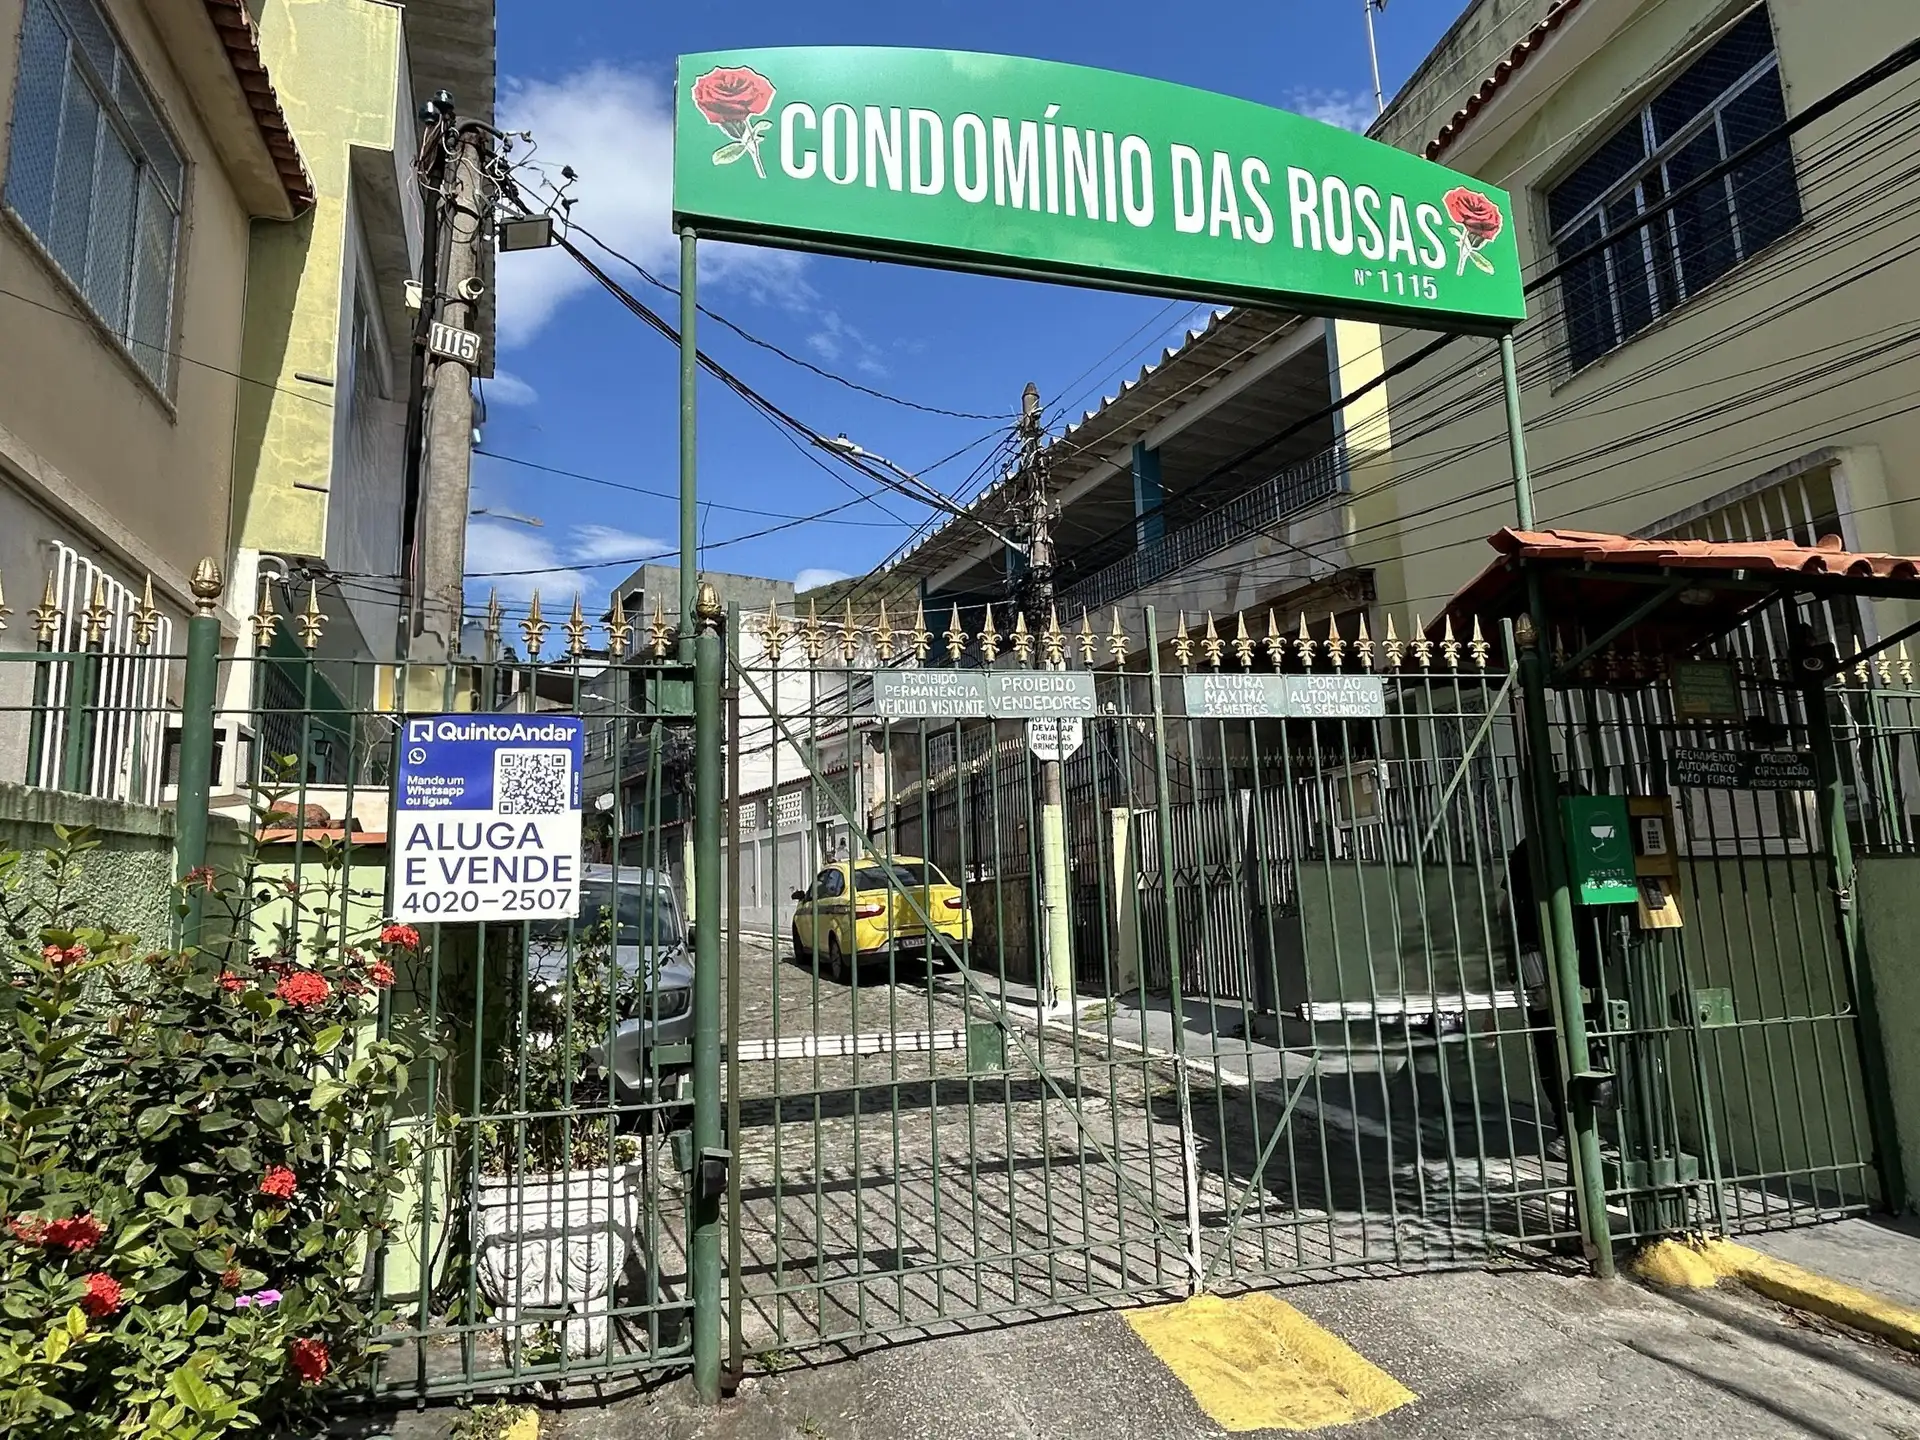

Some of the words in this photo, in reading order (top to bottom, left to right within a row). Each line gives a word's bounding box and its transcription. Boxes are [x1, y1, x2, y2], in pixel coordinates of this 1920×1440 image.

[780, 101, 1154, 228] CONDOMÍNIO
[1170, 142, 1275, 245] DAS
[1287, 165, 1448, 270] ROSAS
[1377, 269, 1438, 300] 1115
[434, 326, 476, 359] 1115
[901, 672, 958, 685] PROIBIDO
[1001, 677, 1076, 693] PROIBIDO
[1204, 675, 1265, 690] ALTURA
[931, 699, 986, 715] VISITANTE
[991, 695, 1092, 711] VENDEDORES
[437, 721, 577, 742] QuintoAndar
[1032, 724, 1074, 732] DEVAAR
[1036, 733, 1071, 741] CRIANAS
[1675, 749, 1737, 762] FECHAMENTO
[407, 775, 445, 785] Mande
[447, 776, 464, 785] um
[1707, 775, 1739, 786] FORCE
[407, 785, 464, 797] Whatsapp
[405, 797, 421, 806] ou
[422, 795, 453, 808] ligue.
[405, 822, 544, 850] ALUGA
[406, 857, 426, 885] E
[438, 855, 572, 884] VENDE
[402, 889, 572, 913] 4020-2507
